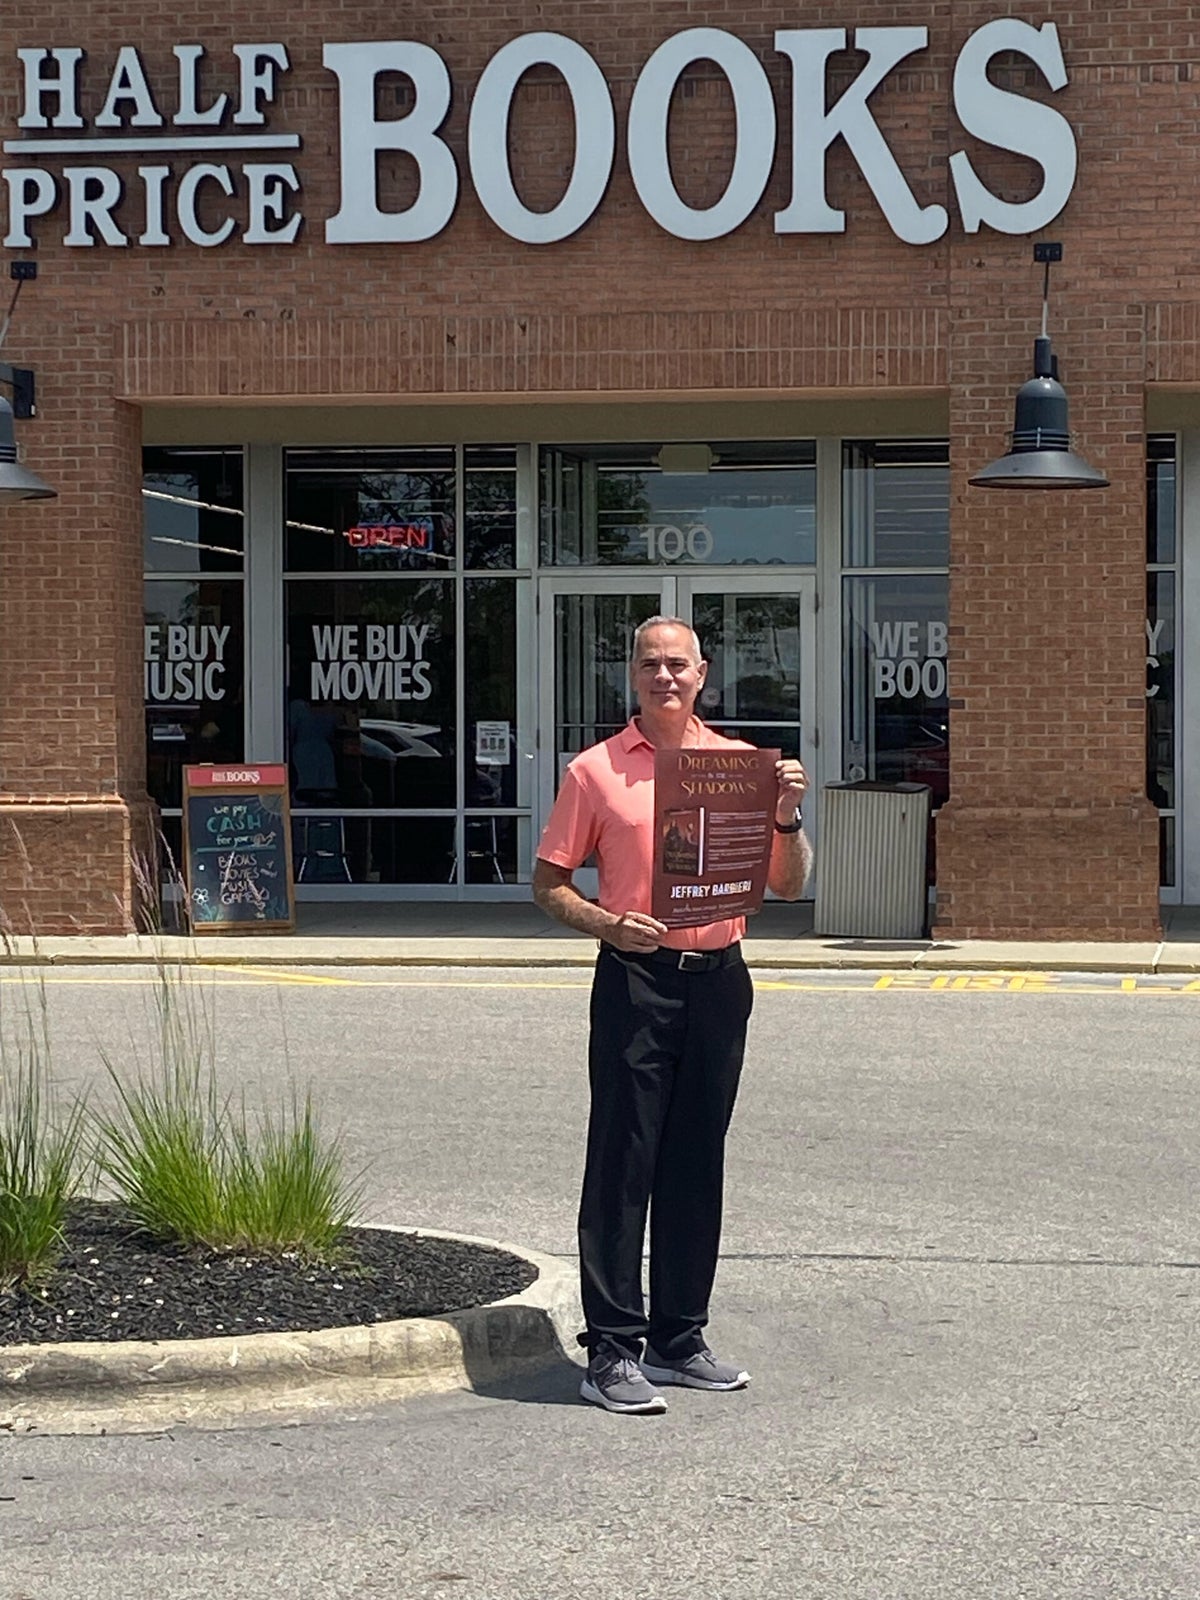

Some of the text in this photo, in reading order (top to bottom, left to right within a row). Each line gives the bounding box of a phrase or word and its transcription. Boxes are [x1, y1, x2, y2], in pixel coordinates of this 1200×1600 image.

[17, 43, 290, 131] HALF
[322, 18, 1078, 246] BOOKS
[2, 163, 303, 249] PRICE
[349, 525, 428, 549] OPEN
[639, 527, 714, 561] 100
[167, 625, 231, 661] BUY
[312, 624, 430, 661] WE BUY
[872, 621, 920, 658] WE
[310, 661, 432, 701] MOVIES
[226, 771, 260, 783] BOOKS
[678, 753, 760, 771] DREAMING
[681, 780, 758, 798] SHADOWS
[206, 815, 262, 833] CASH
[670, 885, 711, 899] JEFFREY
